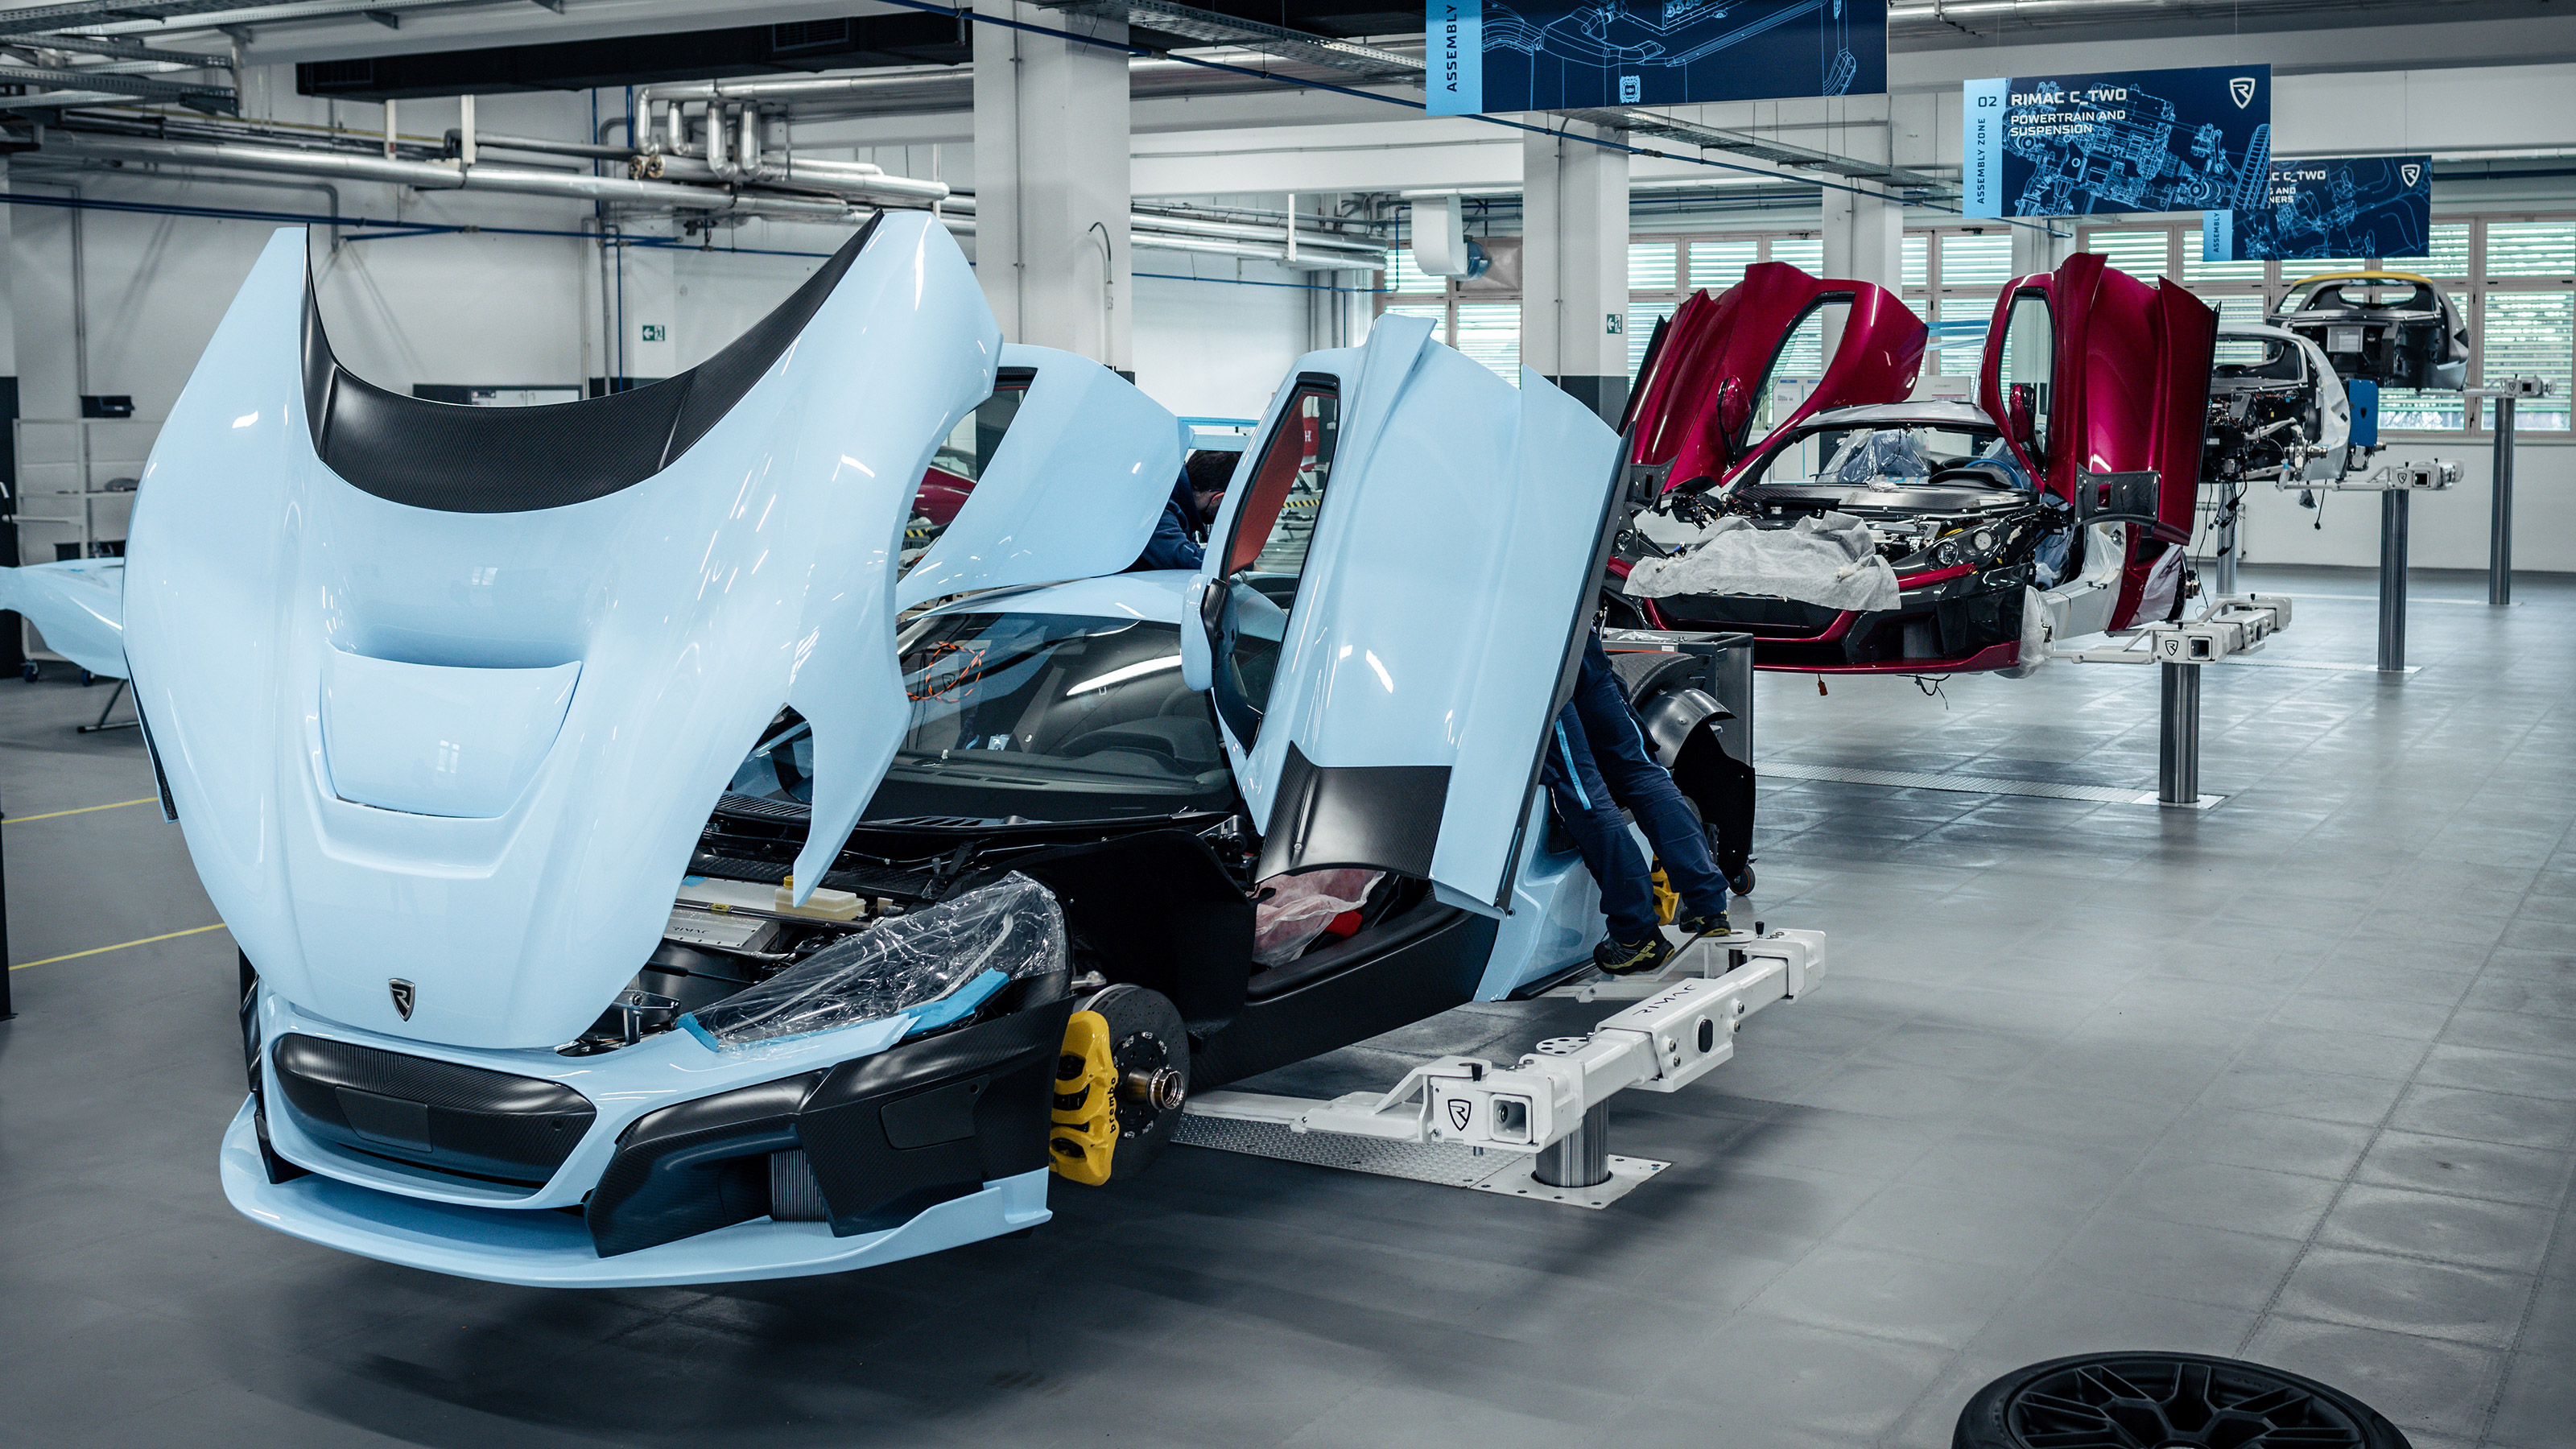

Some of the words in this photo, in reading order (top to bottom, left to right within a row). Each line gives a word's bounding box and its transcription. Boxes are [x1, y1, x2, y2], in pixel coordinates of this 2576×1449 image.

[1447, 5, 1457, 93] ASSEMBLY
[1978, 96, 1997, 107] 02
[2011, 92, 2065, 106] RIMAC
[2070, 89, 2127, 105] C_TWO
[2011, 112, 2095, 125] POWERTRAIN
[2099, 110, 2125, 121] AND
[1978, 118, 1986, 145] ZONE
[2010, 124, 2093, 137] SUSPENSION
[1977, 151, 1985, 204] ASSEMBLY
[2283, 170, 2326, 183] C_TWO
[2276, 187, 2296, 195] AND
[1632, 984, 1697, 1016] RIMAC
[1108, 1077, 1117, 1133] brembo
